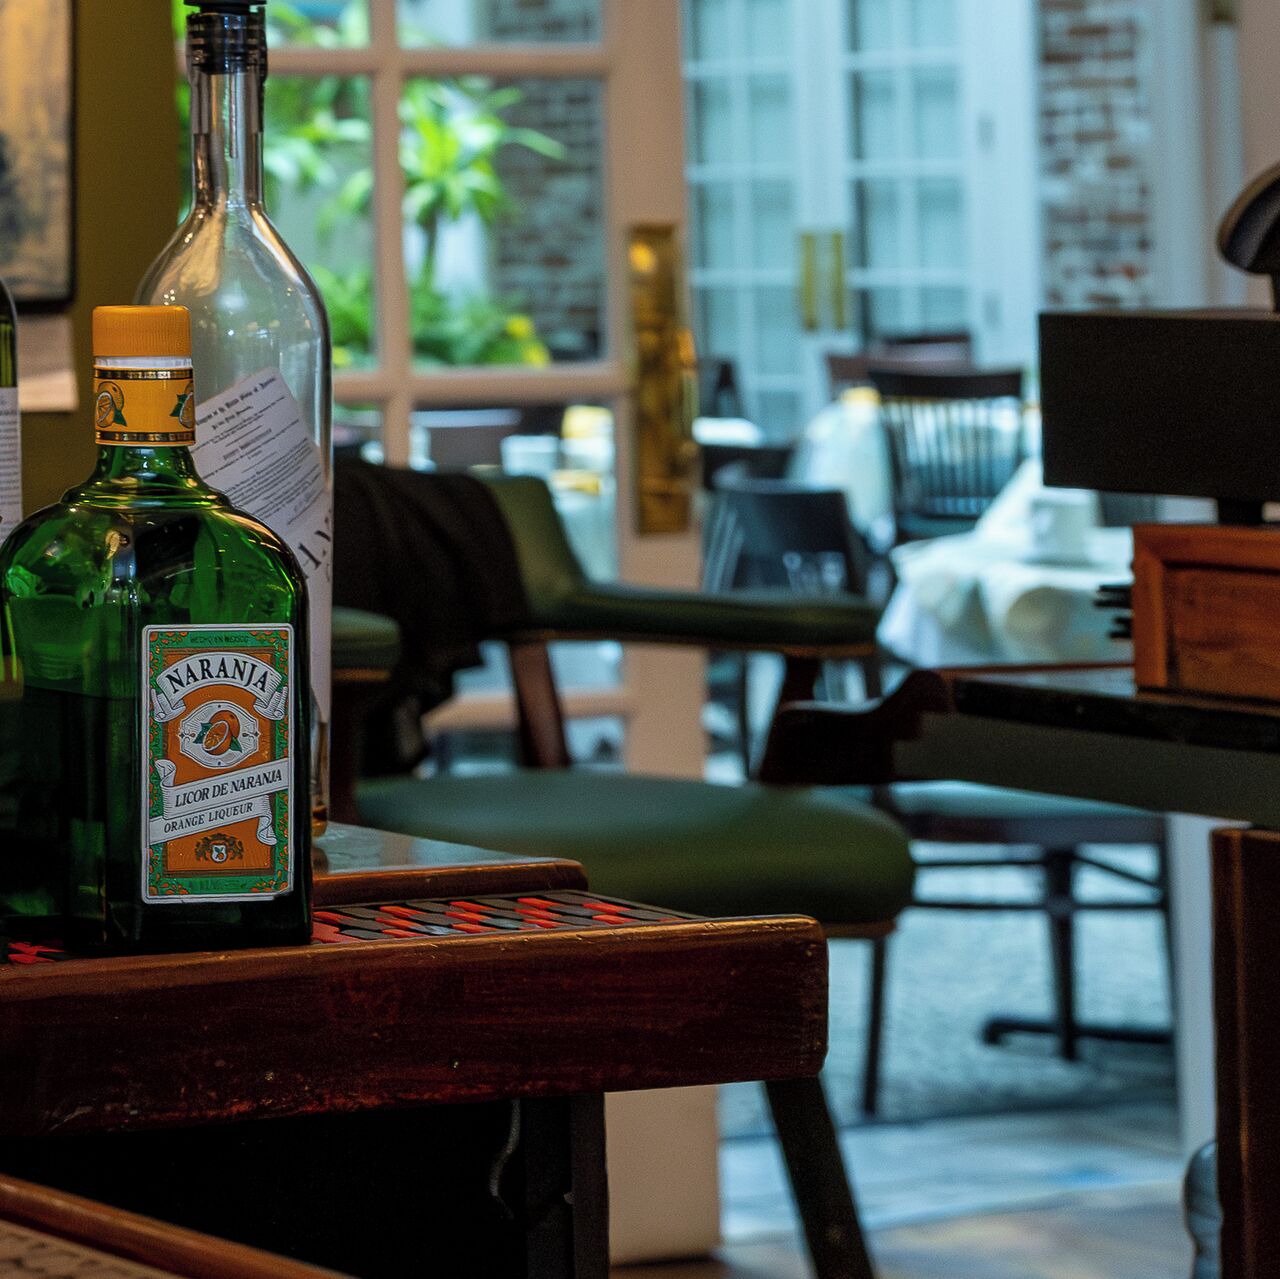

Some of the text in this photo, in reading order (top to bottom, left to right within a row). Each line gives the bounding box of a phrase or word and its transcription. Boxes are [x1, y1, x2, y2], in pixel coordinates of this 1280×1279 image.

[165, 657, 270, 694] NARANJA
[174, 768, 282, 808] LICOR DE NARANJA
[163, 802, 254, 834] ORANGE LIQUEUR
